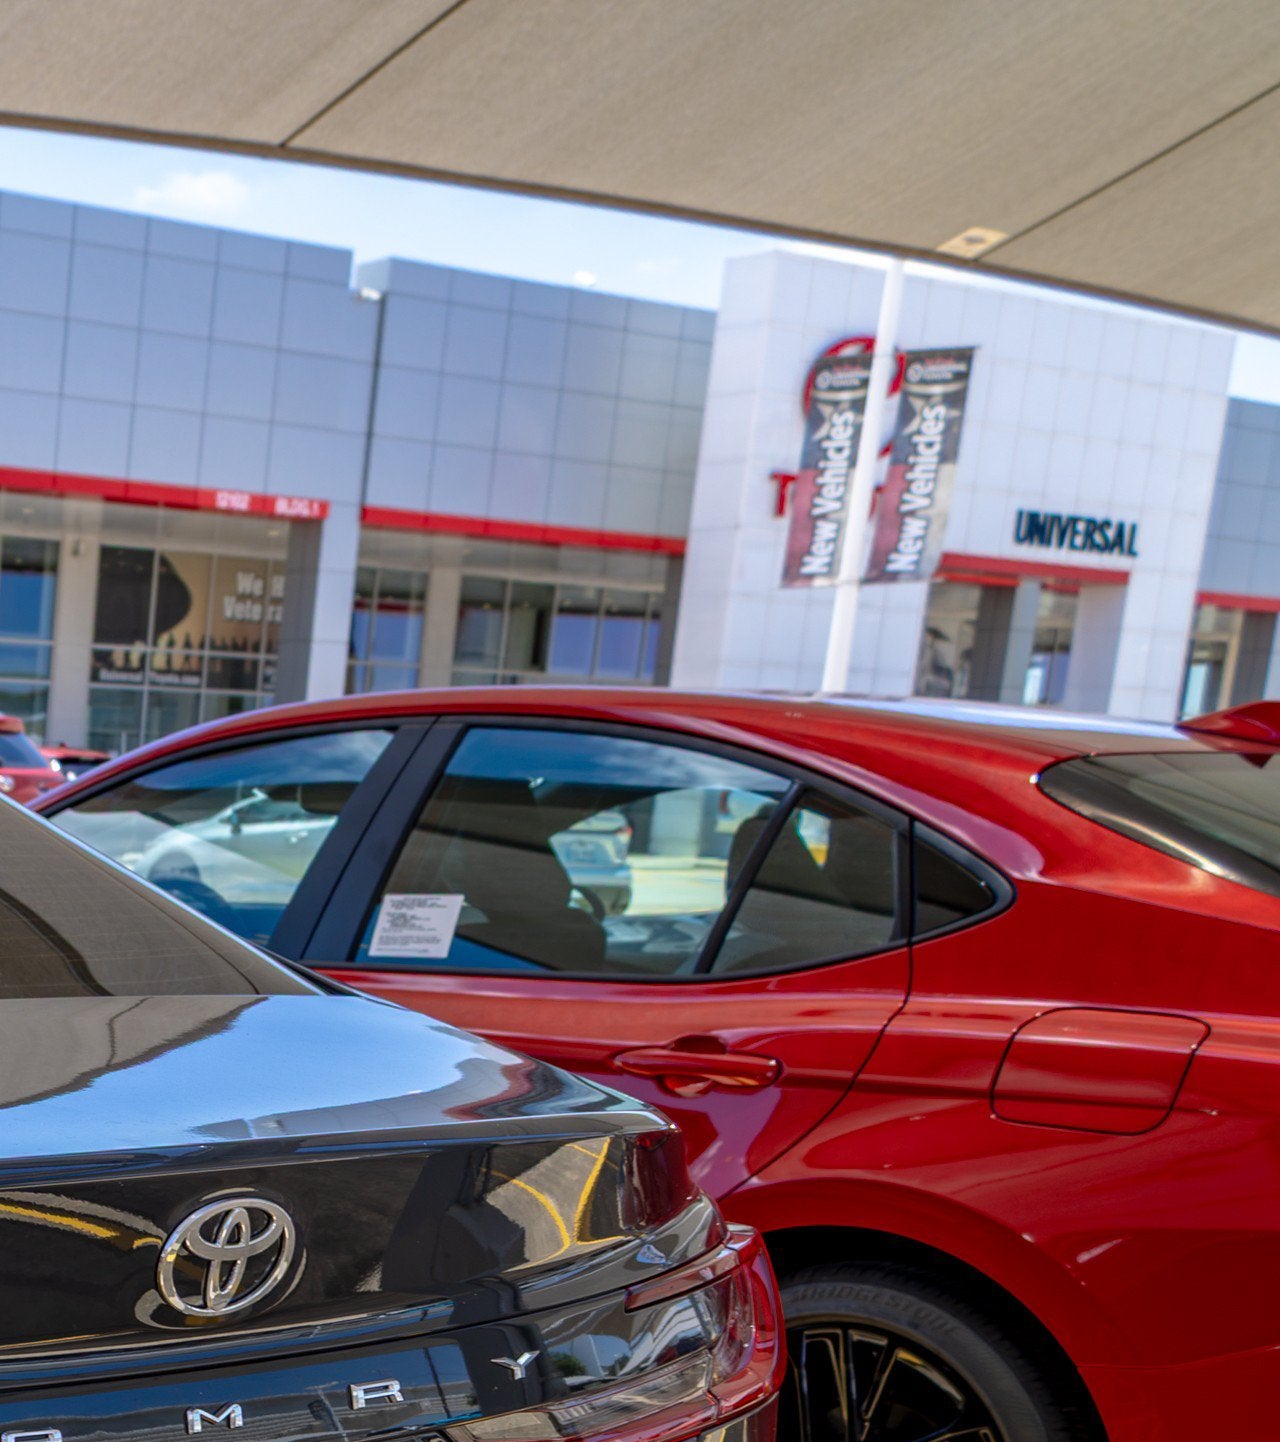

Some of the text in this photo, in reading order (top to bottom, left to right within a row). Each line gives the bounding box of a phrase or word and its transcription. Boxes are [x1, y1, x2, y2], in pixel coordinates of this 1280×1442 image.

[811, 409, 857, 516] Vehicles
[899, 404, 947, 514] Vehicles
[801, 519, 841, 576] New
[885, 515, 925, 574] New
[1014, 509, 1139, 557] UNIVERSAL
